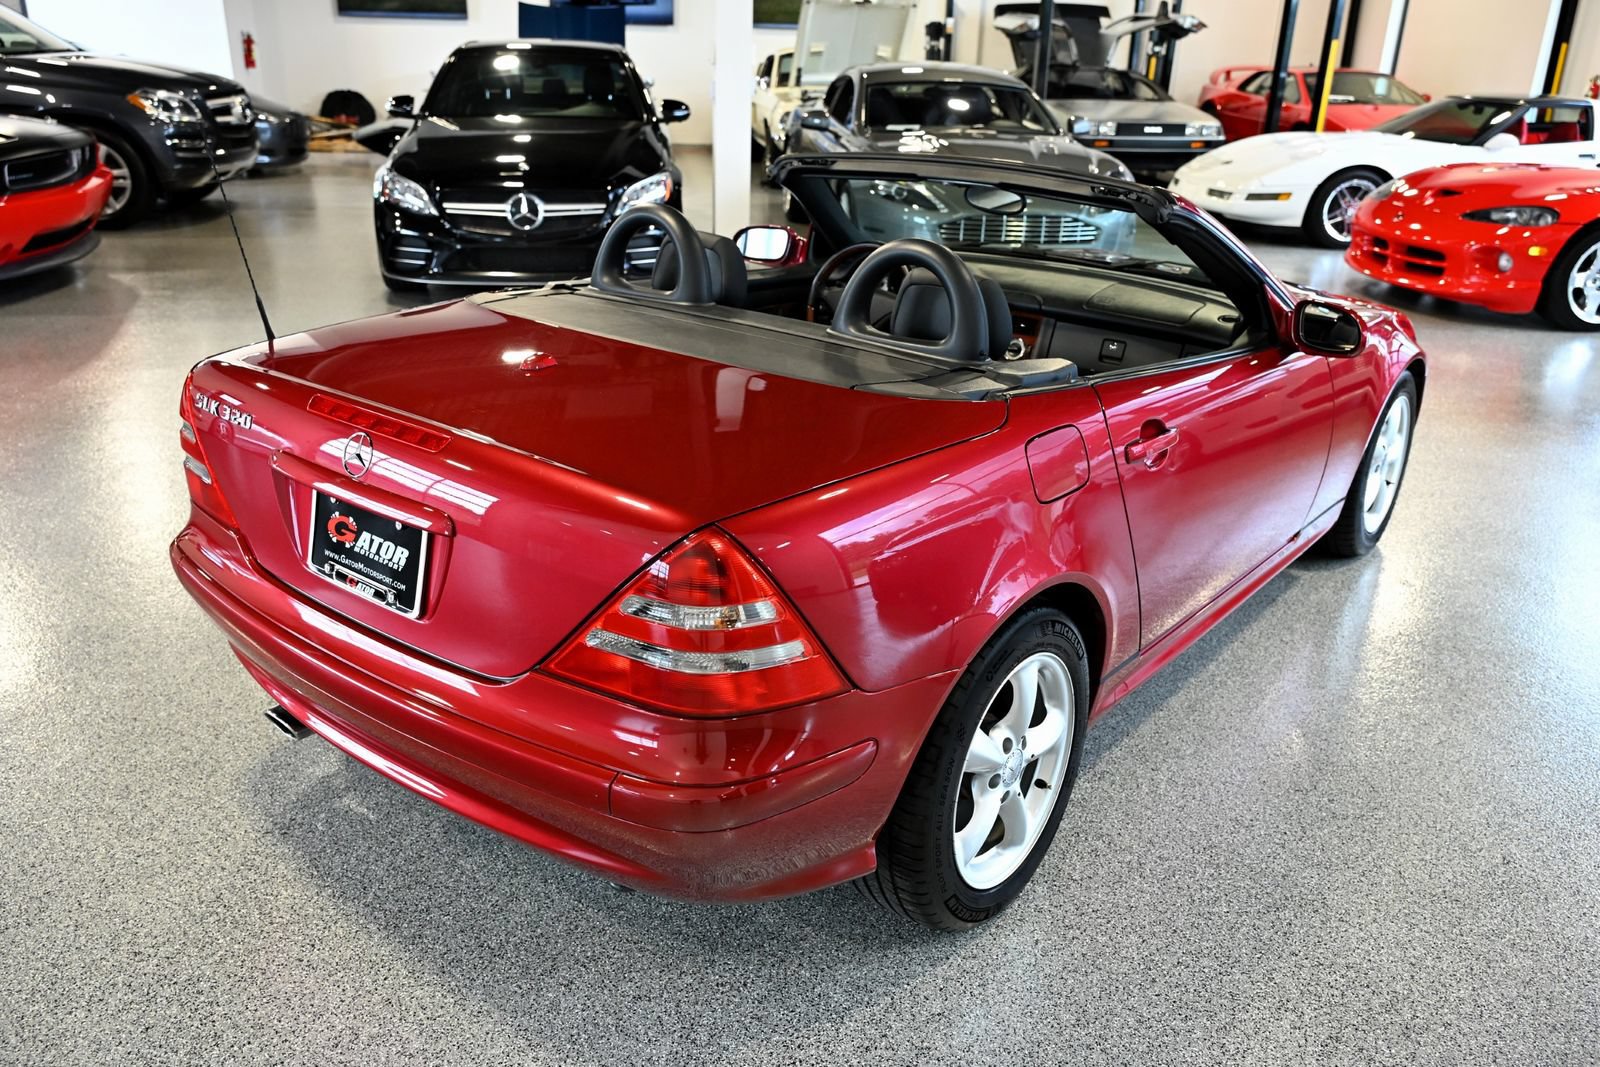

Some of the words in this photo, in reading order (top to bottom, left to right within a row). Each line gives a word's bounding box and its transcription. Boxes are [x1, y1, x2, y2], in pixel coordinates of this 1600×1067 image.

[194, 393, 221, 417] SLK
[220, 404, 252, 430] 320
[327, 513, 409, 566] GATOR
[353, 546, 404, 572] MOTORSPORT
[346, 576, 376, 596] GATOR
[1053, 622, 1084, 659] MICHELIN
[940, 757, 955, 807] SEASON
[936, 812, 944, 831] ALL
[935, 837, 943, 869] SPORT
[946, 897, 987, 921] MICHELIN
